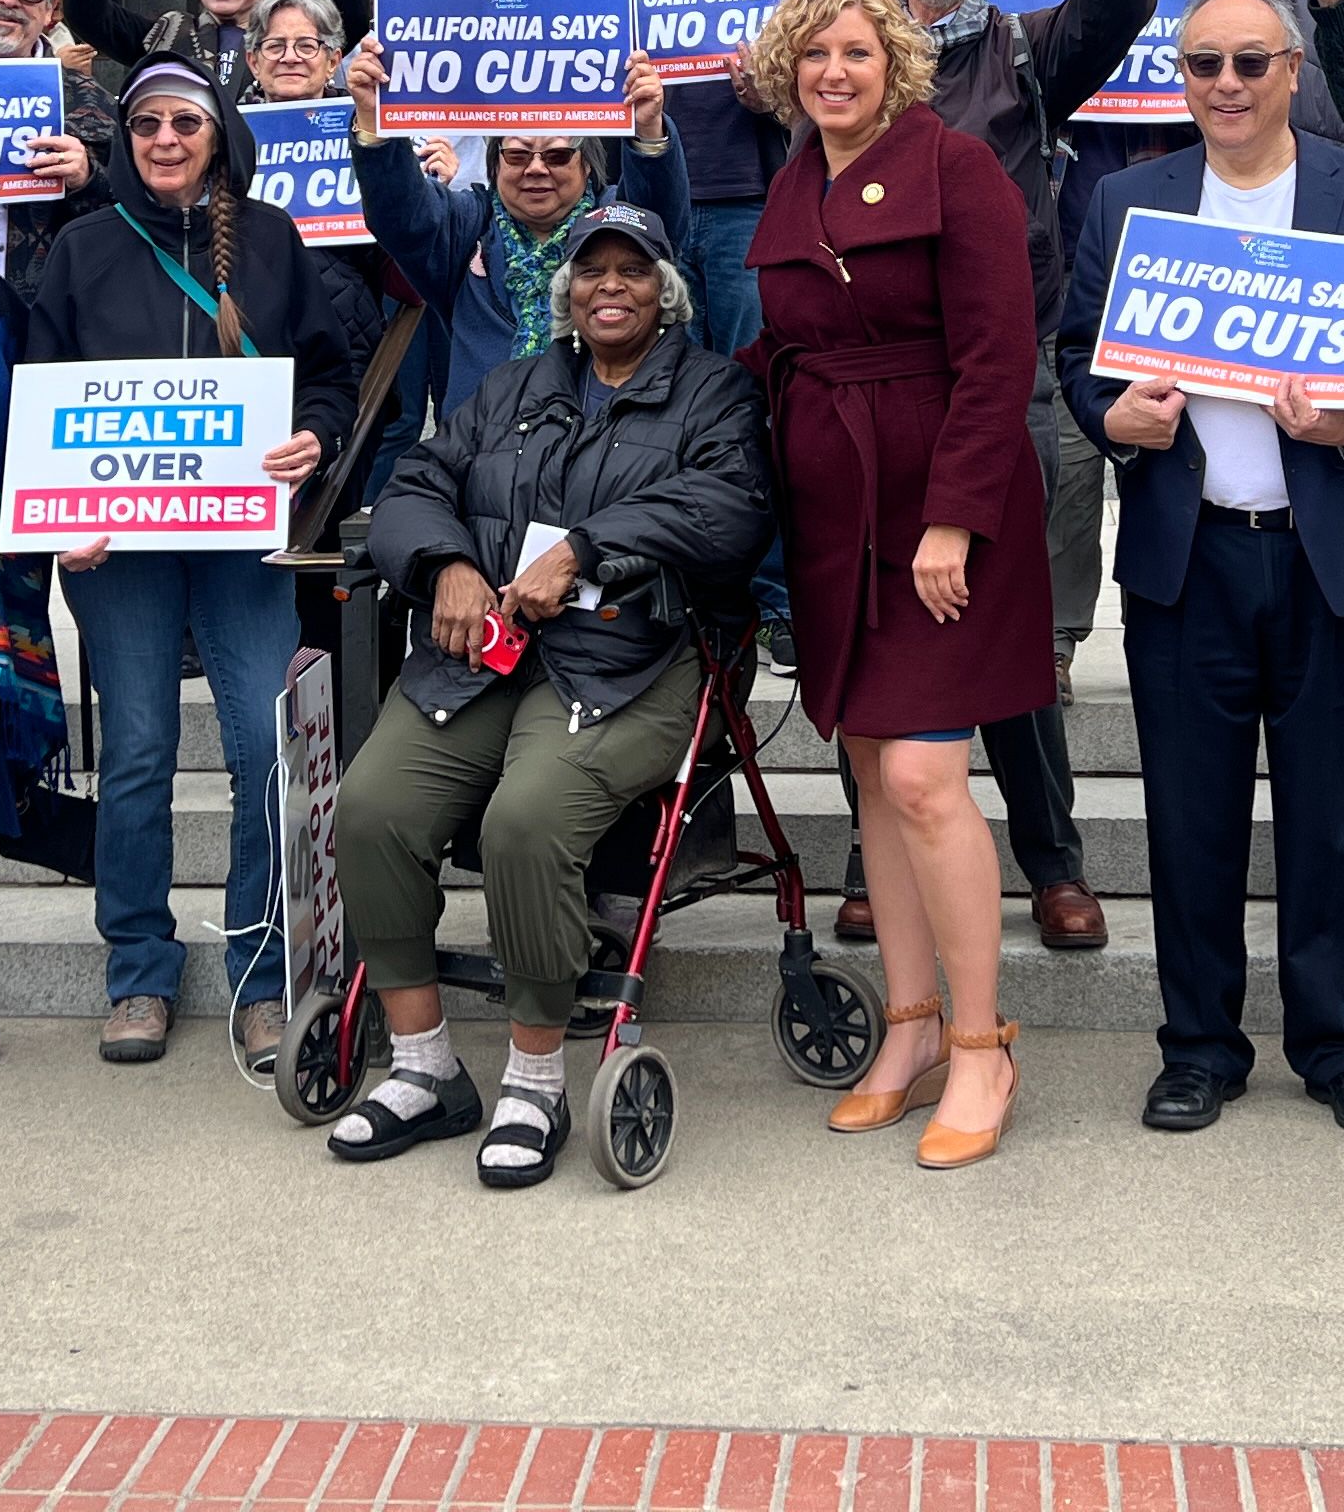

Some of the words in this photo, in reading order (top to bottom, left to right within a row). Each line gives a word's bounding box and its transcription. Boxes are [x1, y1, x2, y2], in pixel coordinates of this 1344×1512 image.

[385, 15, 543, 41] CALIFORNIA
[550, 14, 620, 40] SAYS
[646, 11, 705, 50] NO
[388, 50, 462, 93] NO
[475, 49, 620, 94] CUTS!
[654, 62, 694, 73] ALIFORNIA
[385, 111, 445, 122] CALIFORNIA
[449, 111, 496, 122] ALLIANCE
[498, 111, 517, 121] FOR
[520, 111, 562, 121] RETIRED
[565, 110, 626, 121] AMERICANS
[1102, 98, 1139, 108] RETIRED
[2, 178, 58, 190] AMERICANS
[326, 221, 344, 231] FOR
[1127, 253, 1303, 304] CALIFORNIA
[1114, 288, 1204, 342] NO
[1104, 349, 1171, 371] CALIFORNIA
[1172, 361, 1227, 379] ALLIANCE
[1230, 371, 1252, 384] FOR
[84, 380, 143, 402] PUT
[153, 379, 219, 401] OUR
[64, 409, 234, 443] HEALTH
[90, 453, 203, 481] OVER
[23, 496, 266, 525] BILLIONAIRES
